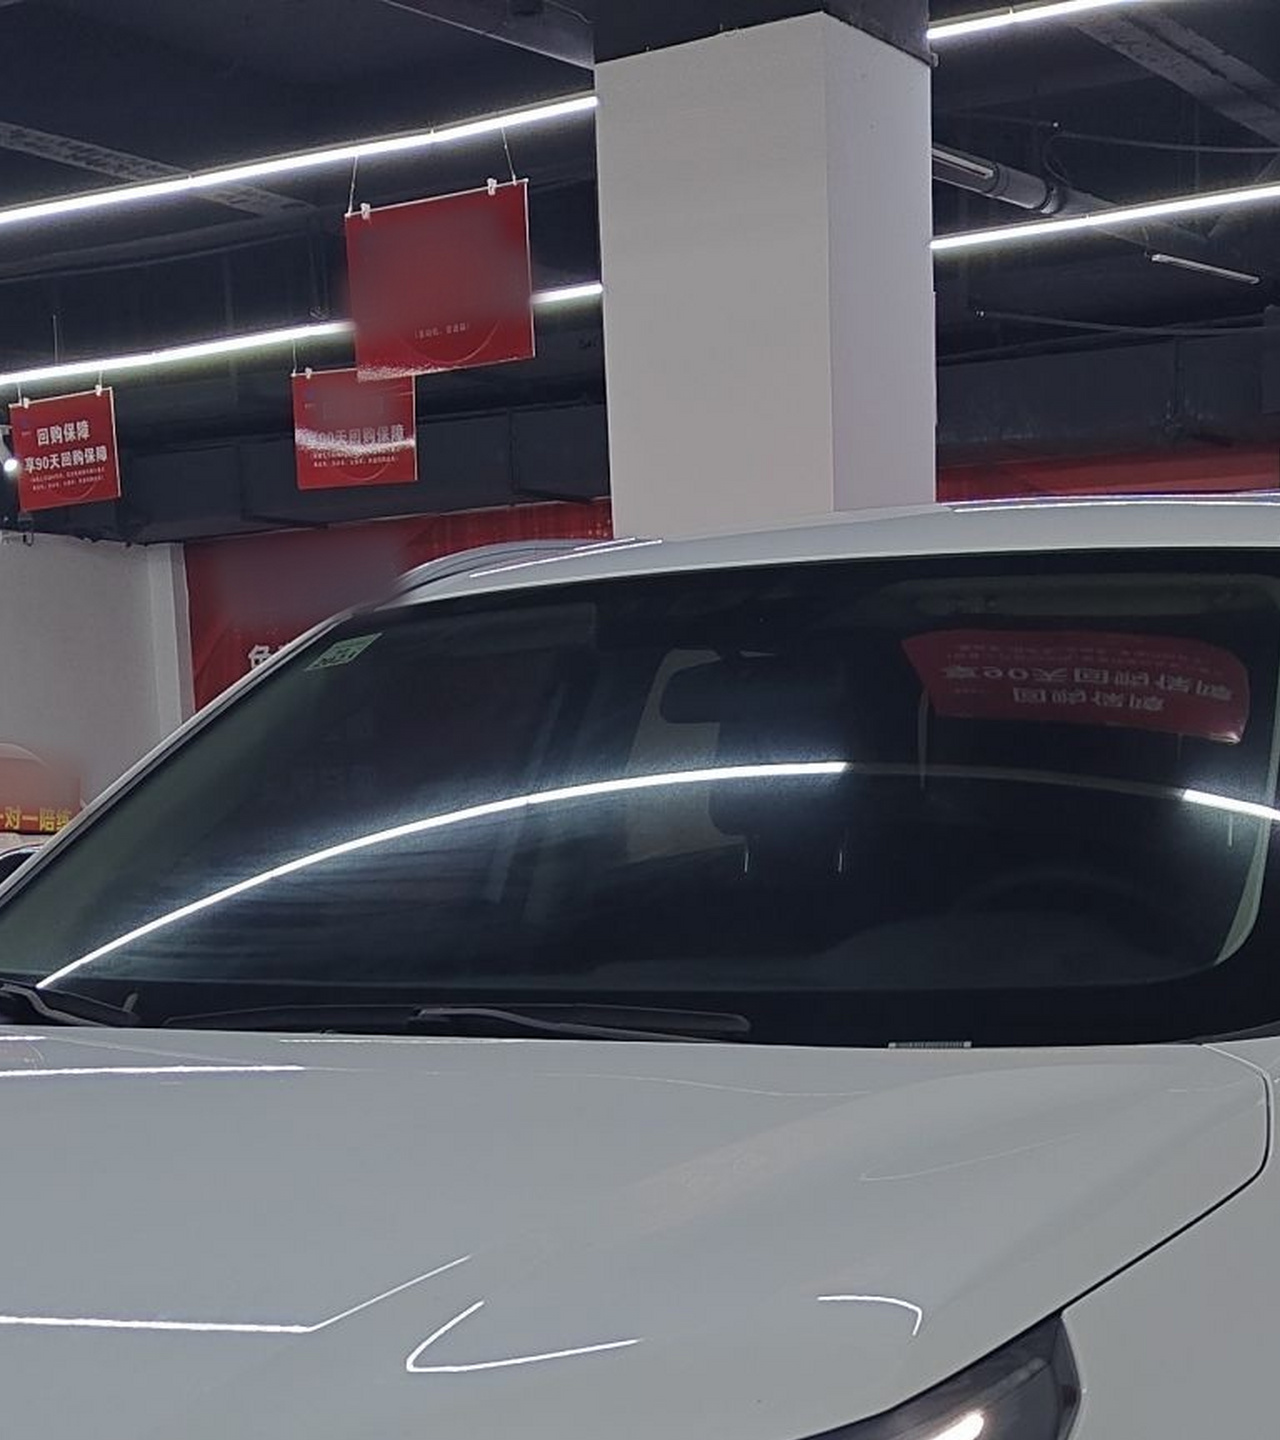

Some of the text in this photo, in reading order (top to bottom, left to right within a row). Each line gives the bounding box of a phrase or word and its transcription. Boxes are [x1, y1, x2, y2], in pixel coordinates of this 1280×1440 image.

[36, 419, 91, 447] 回购保障
[24, 445, 108, 475] 享90天回购保障
